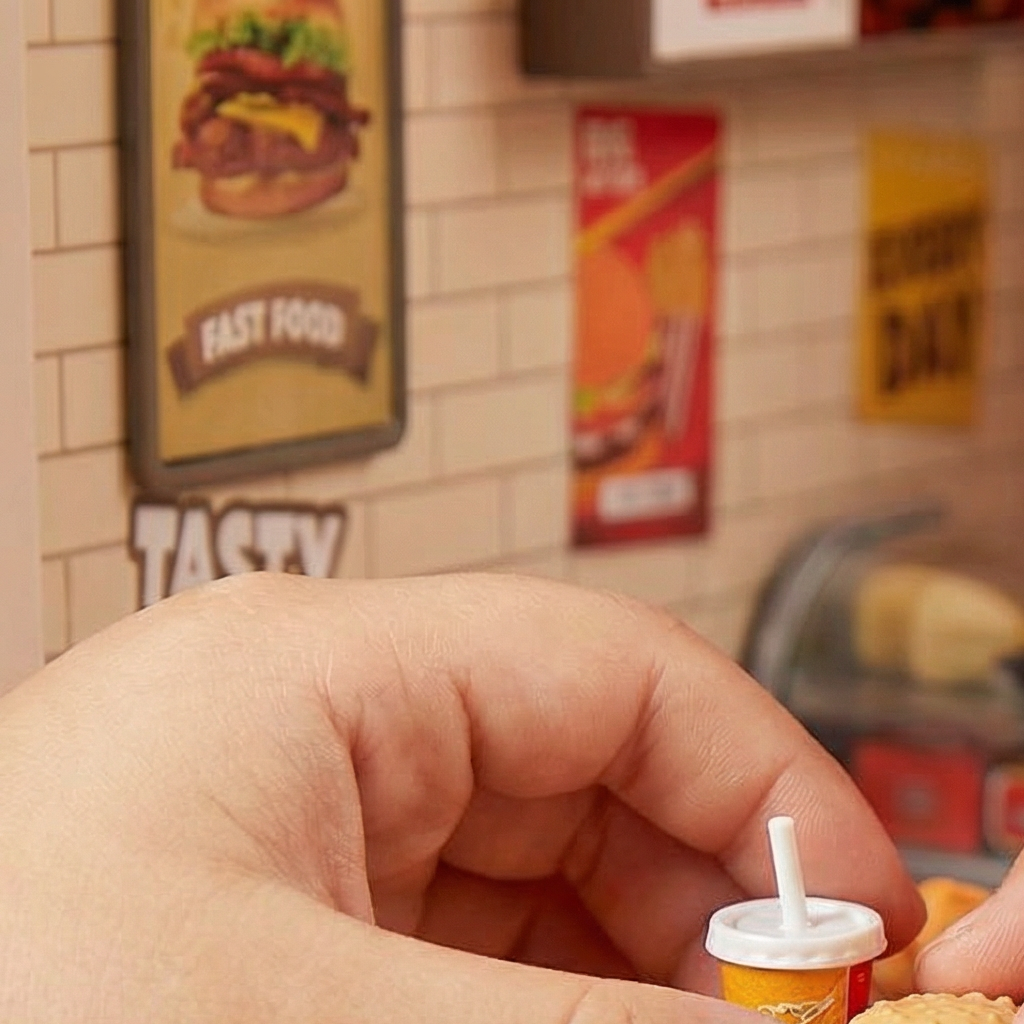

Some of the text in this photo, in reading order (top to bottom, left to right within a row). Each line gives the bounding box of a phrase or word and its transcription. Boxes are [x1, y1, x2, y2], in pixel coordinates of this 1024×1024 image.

[201, 297, 347, 366] FAST FOOD
[131, 501, 346, 609] TASTY
